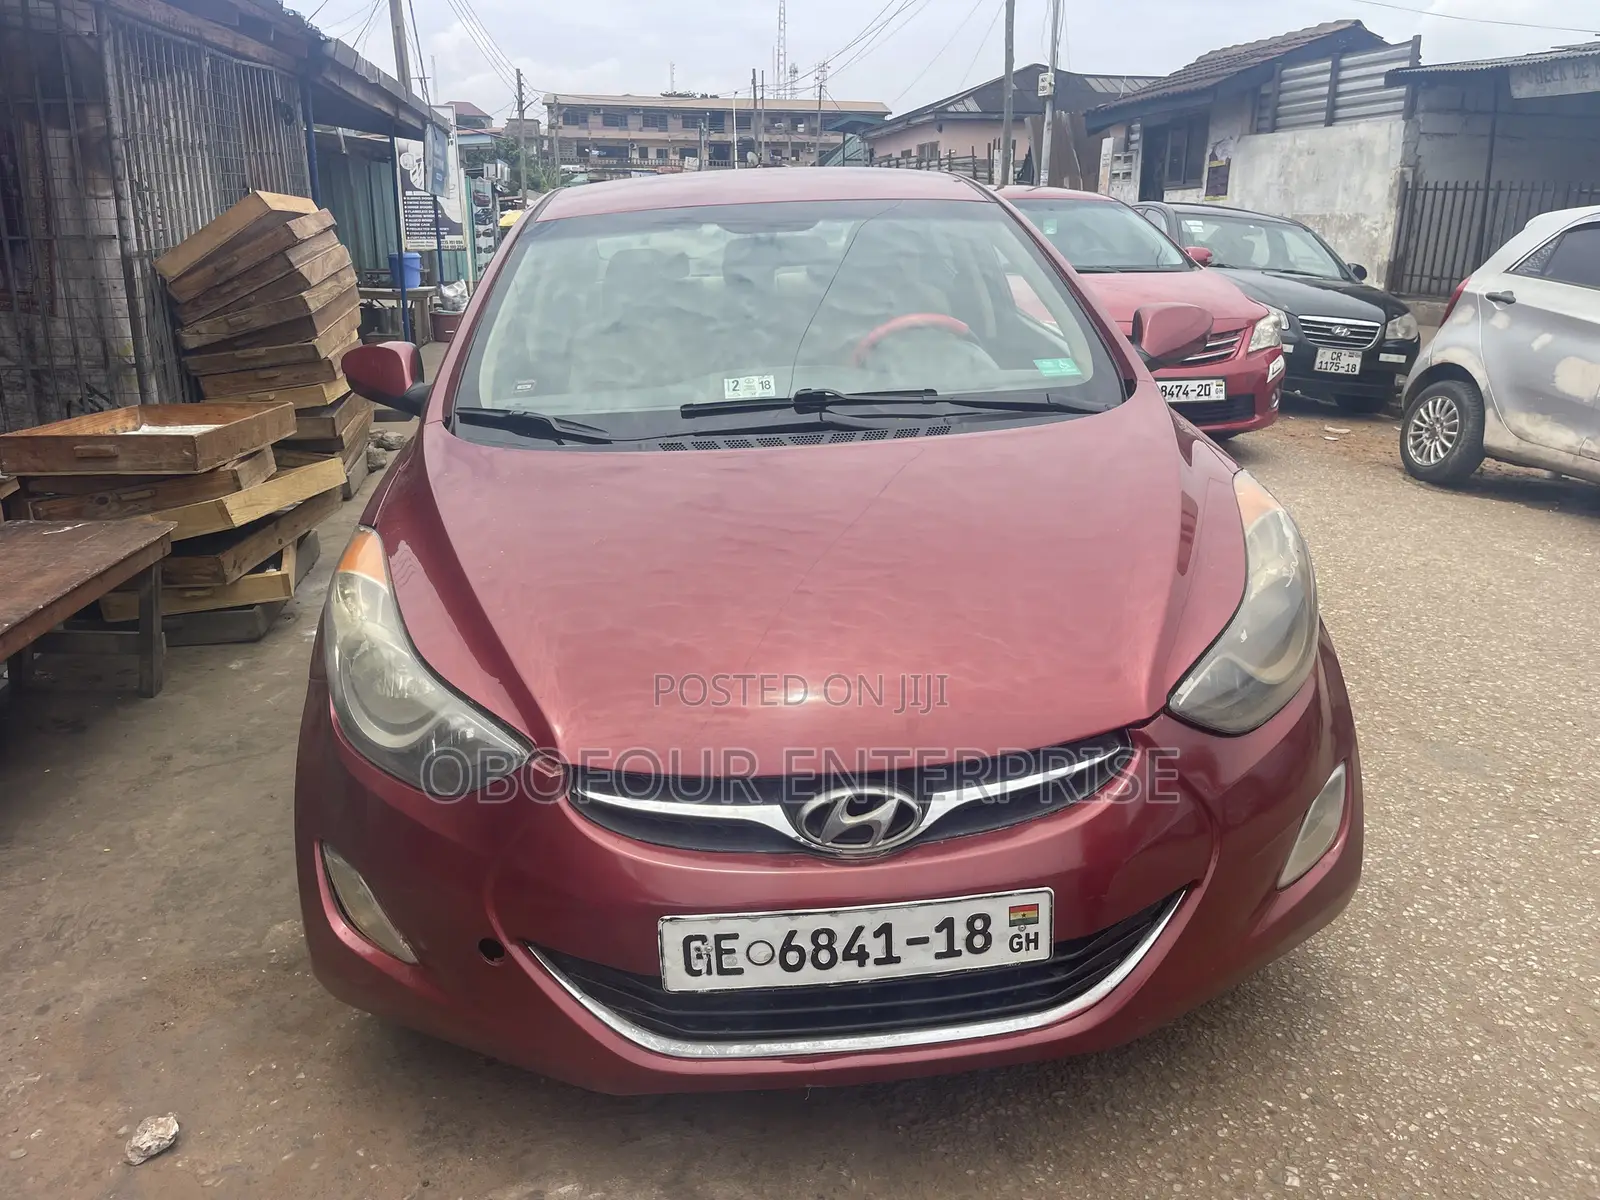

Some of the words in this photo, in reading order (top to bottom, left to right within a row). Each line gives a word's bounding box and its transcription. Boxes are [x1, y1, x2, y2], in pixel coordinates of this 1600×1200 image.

[1331, 351, 1342, 361] CR
[1317, 360, 1357, 373] 1175-18
[759, 379, 771, 390] 18
[1161, 383, 1211, 398] 8474-20
[683, 932, 745, 977] GE
[778, 911, 992, 973] 6841-18
[1008, 931, 1039, 953] GH
